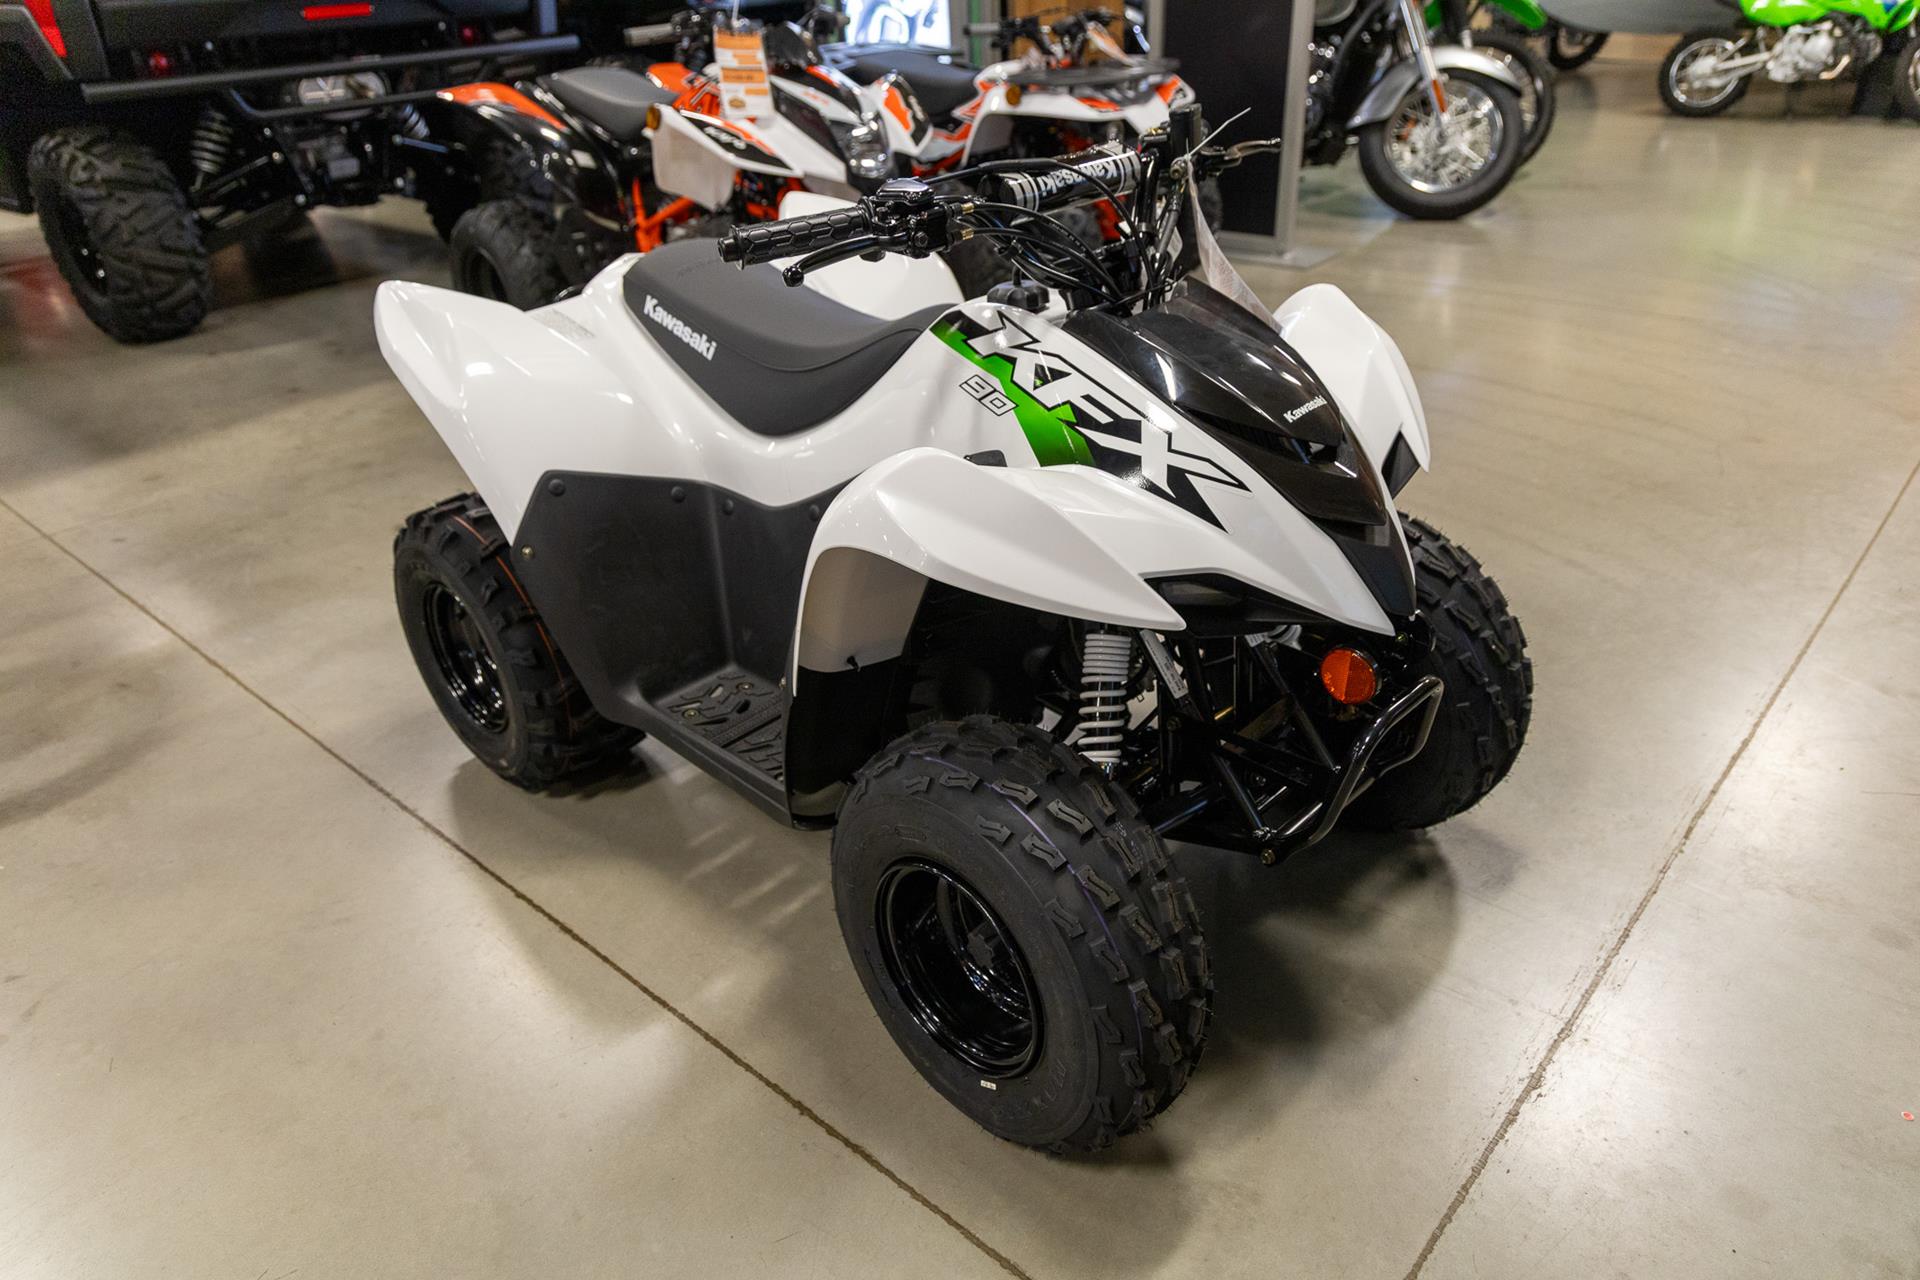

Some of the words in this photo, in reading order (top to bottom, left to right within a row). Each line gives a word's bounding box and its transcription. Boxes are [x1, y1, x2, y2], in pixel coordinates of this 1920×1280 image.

[643, 294, 717, 361] Kawasaki
[960, 374, 1019, 416] 90
[965, 310, 1253, 505] KFX
